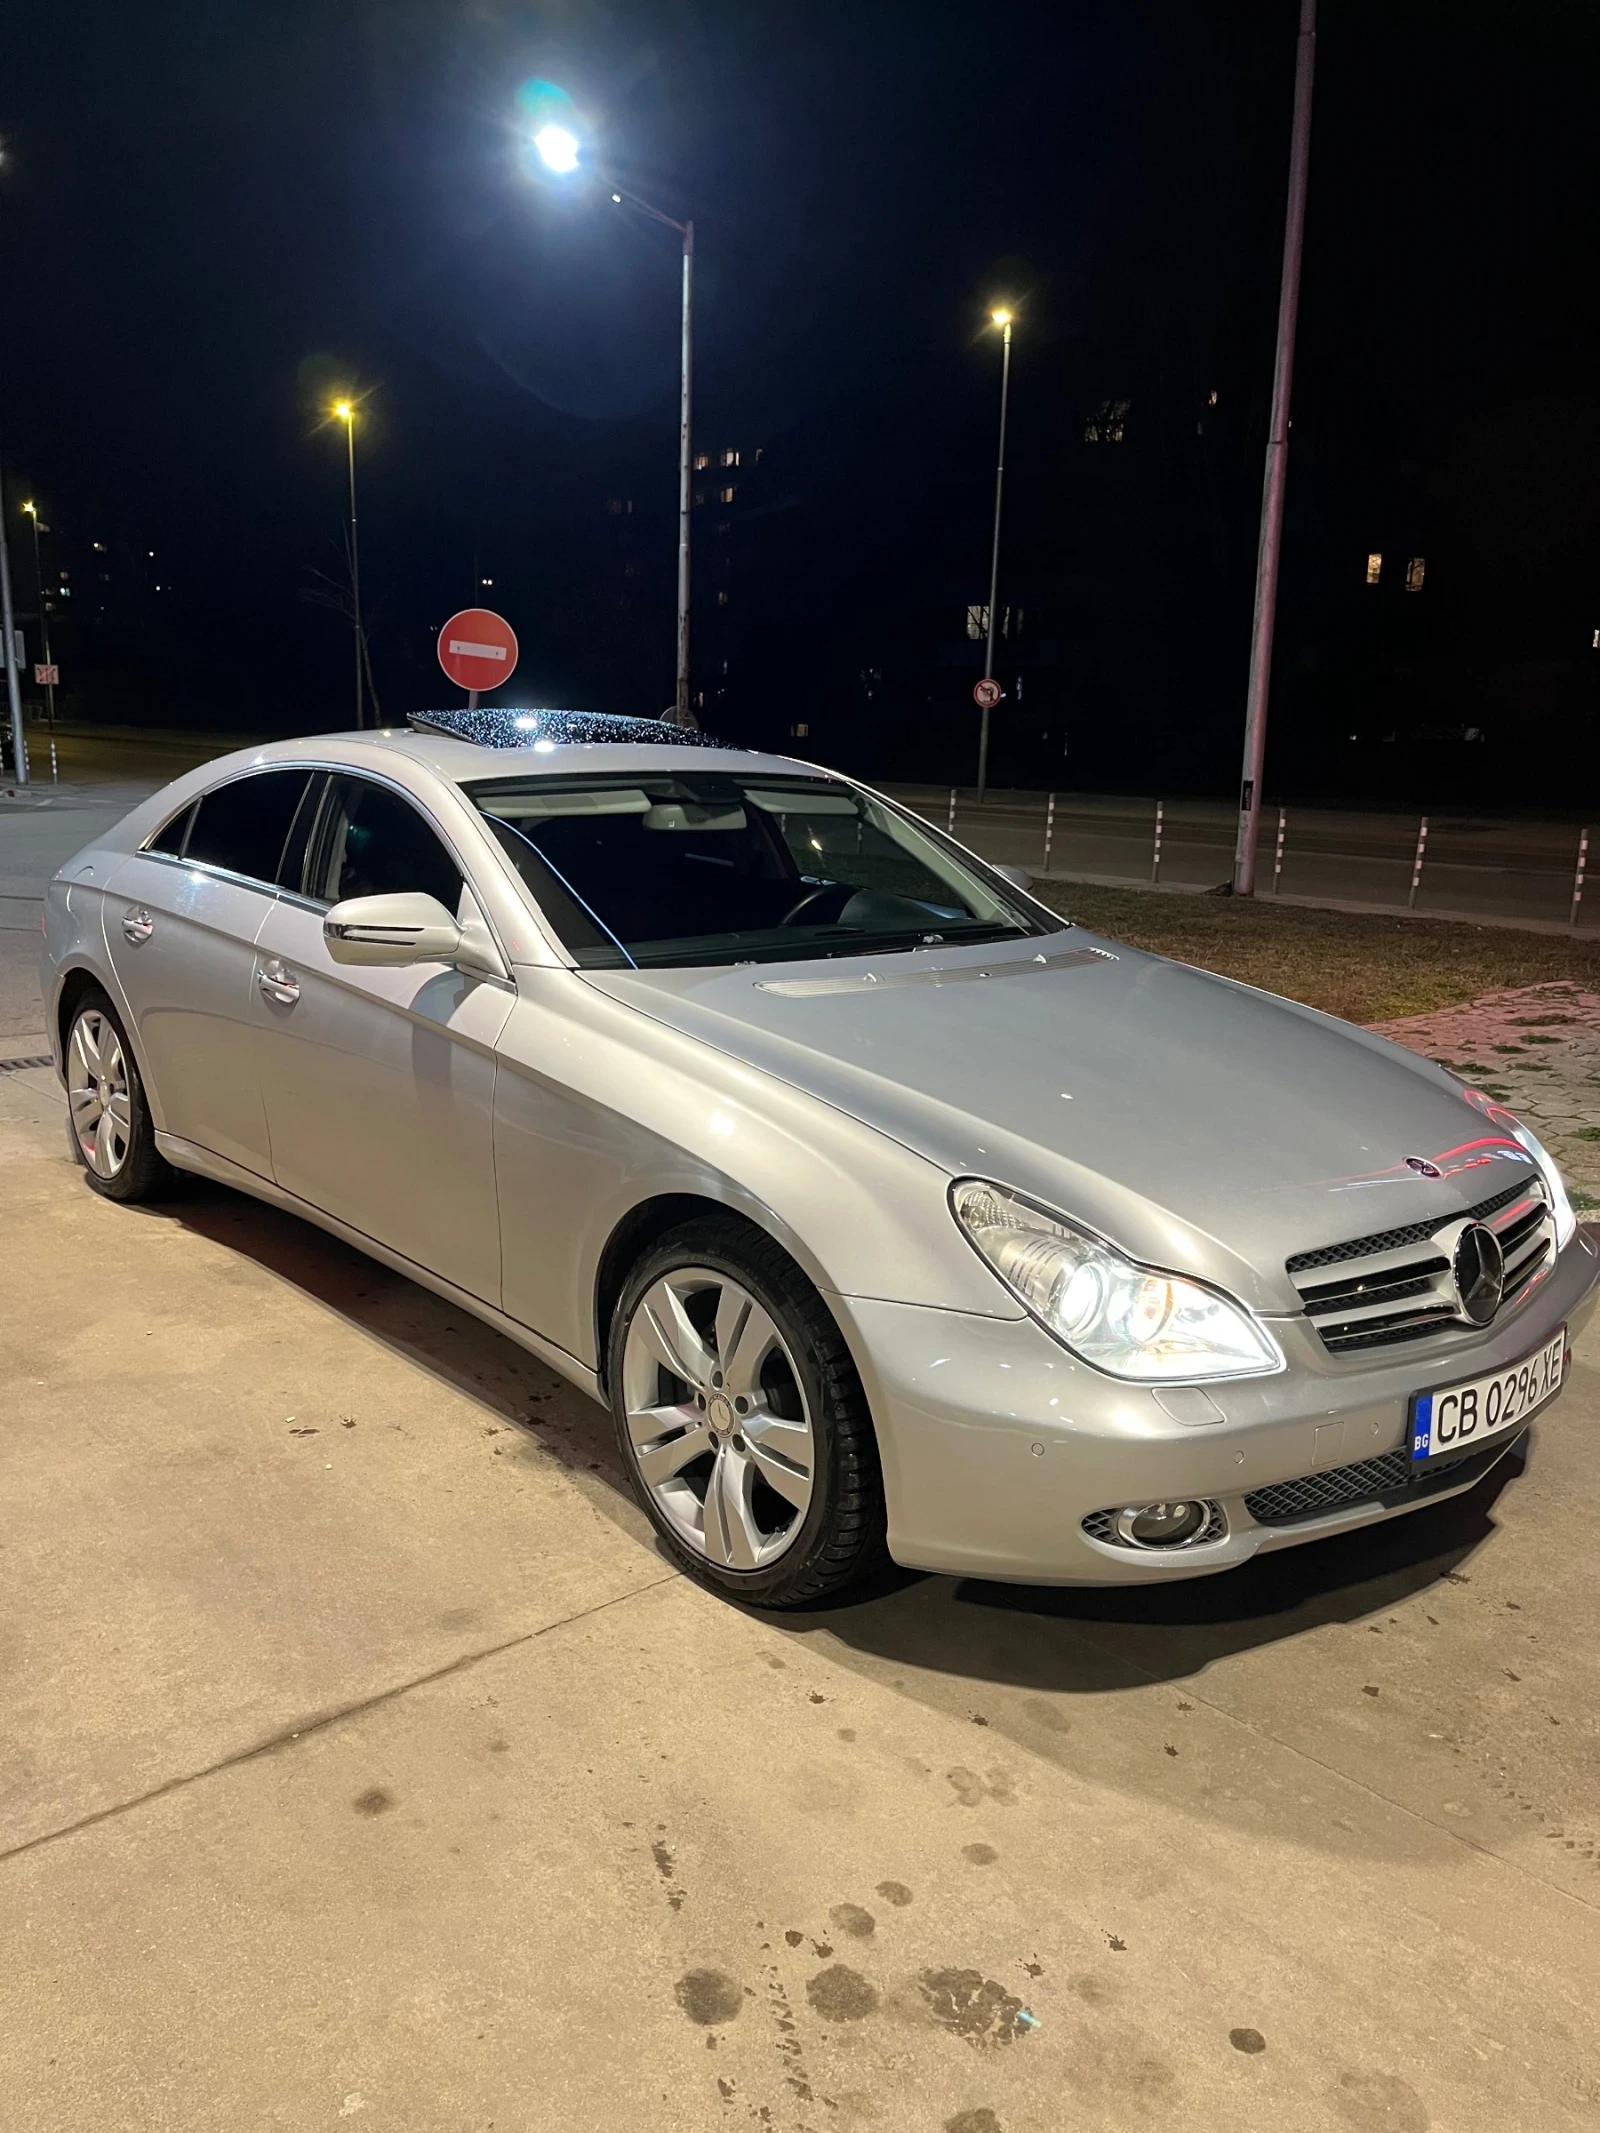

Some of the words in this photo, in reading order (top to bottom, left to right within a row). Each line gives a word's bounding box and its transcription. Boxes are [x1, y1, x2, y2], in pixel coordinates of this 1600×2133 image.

[1437, 1389, 1478, 1444] CB
[1485, 1358, 1538, 1427] 0296
[1540, 1340, 1561, 1396] XE
[1414, 1434, 1429, 1451] BG
